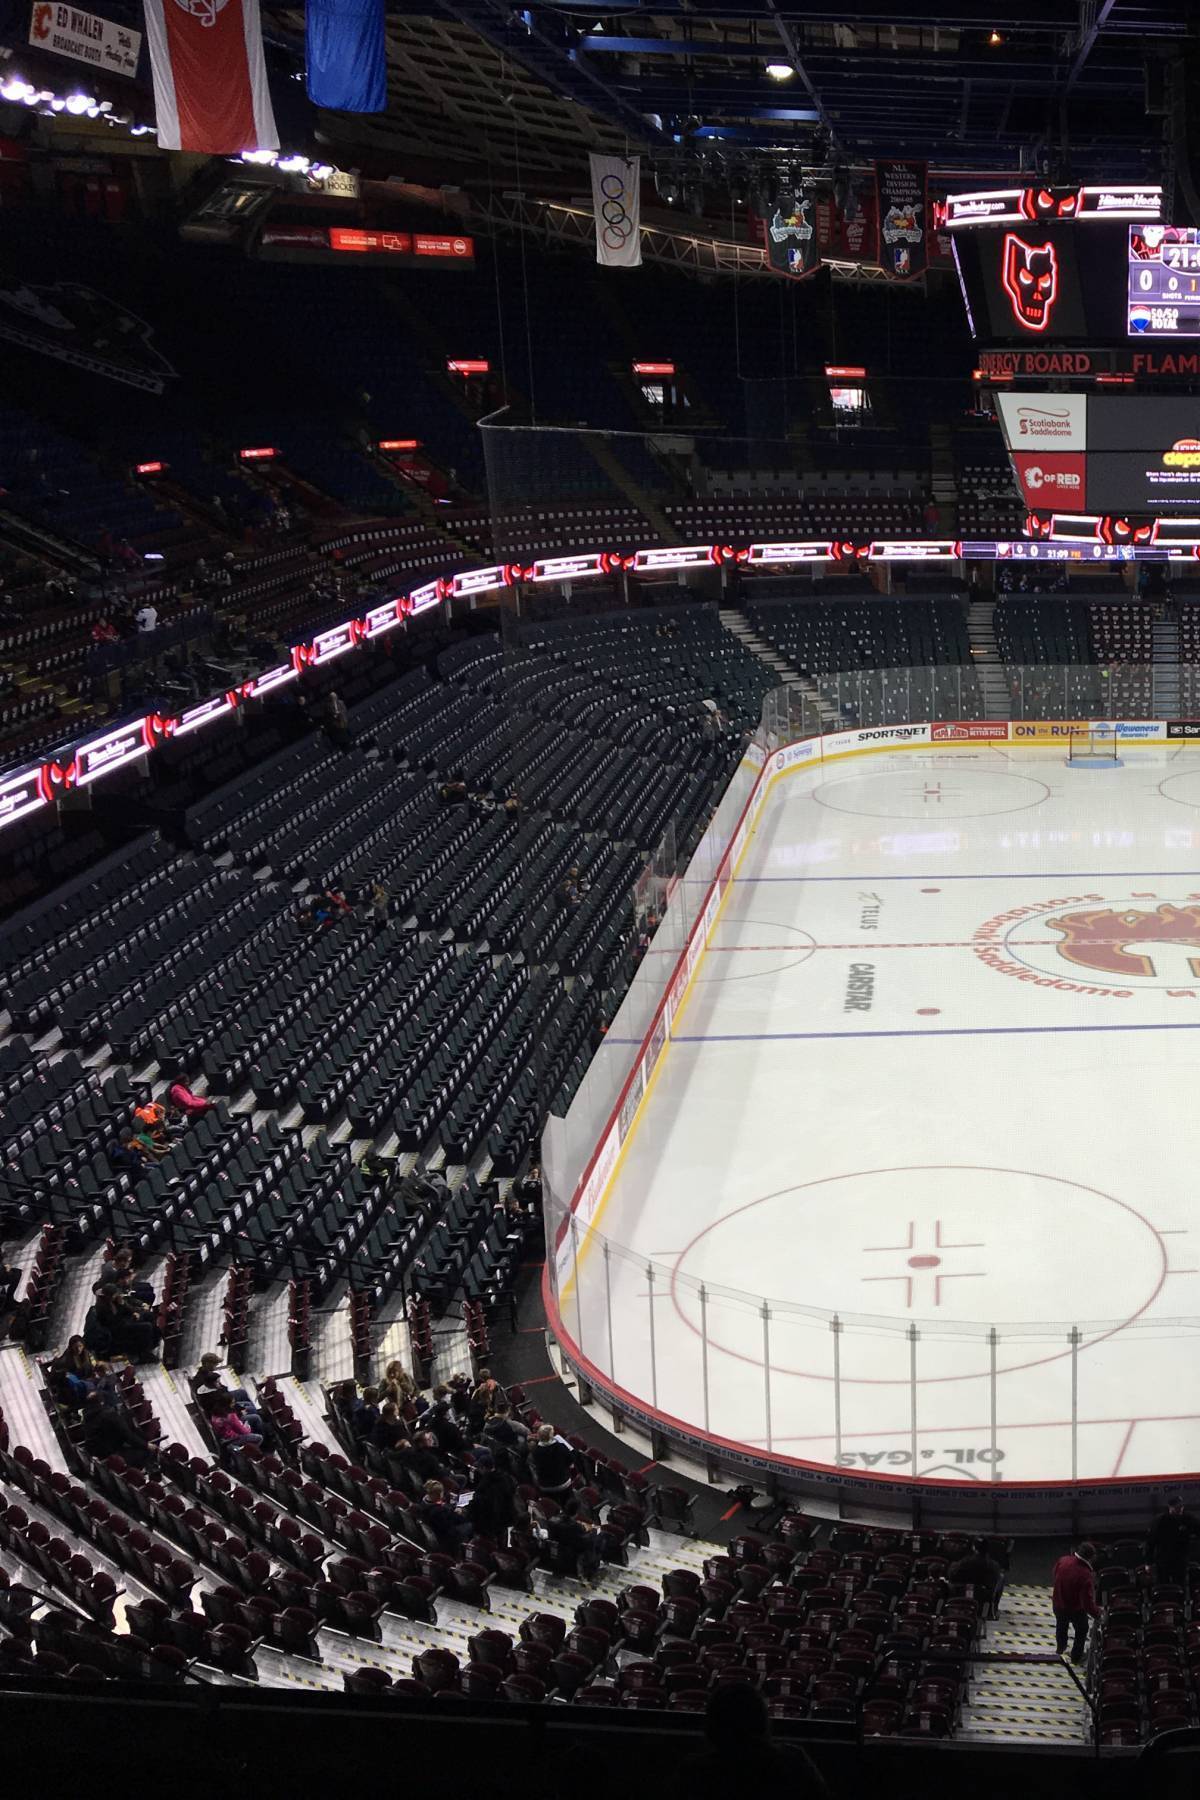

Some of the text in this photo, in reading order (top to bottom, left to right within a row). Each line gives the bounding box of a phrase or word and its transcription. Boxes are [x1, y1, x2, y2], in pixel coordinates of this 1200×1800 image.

[57, 6, 103, 41] ED WHALEN
[327, 181, 355, 193] HOCKEY
[882, 187, 921, 196] CHAMPIONS
[1139, 269, 1153, 291] 0
[1168, 277, 1178, 291] 0
[1190, 278, 1197, 293] 1
[1162, 292, 1182, 300] SHOTS
[1152, 308, 1179, 320] 50/50
[1152, 319, 1178, 330] TOTAL
[1025, 353, 1090, 375] BOARD
[1029, 418, 1071, 429] Scotiabank
[1030, 428, 1072, 437] Saddledome
[1044, 474, 1056, 482] OF
[1055, 473, 1080, 485] RED
[1030, 545, 1038, 557] 0
[1047, 549, 1069, 558] 21:09
[1093, 545, 1101, 557] 0
[858, 726, 928, 742] SPORTSNET
[1015, 726, 1036, 737] ON
[1050, 725, 1080, 737] RUN
[1115, 723, 1160, 734] Wawanesa
[860, 905, 880, 930] TELUS
[972, 892, 1105, 942] Scotiabank
[973, 946, 1134, 999] Saddledome
[836, 1449, 914, 1467] GAS
[944, 1448, 1005, 1464] OIL
